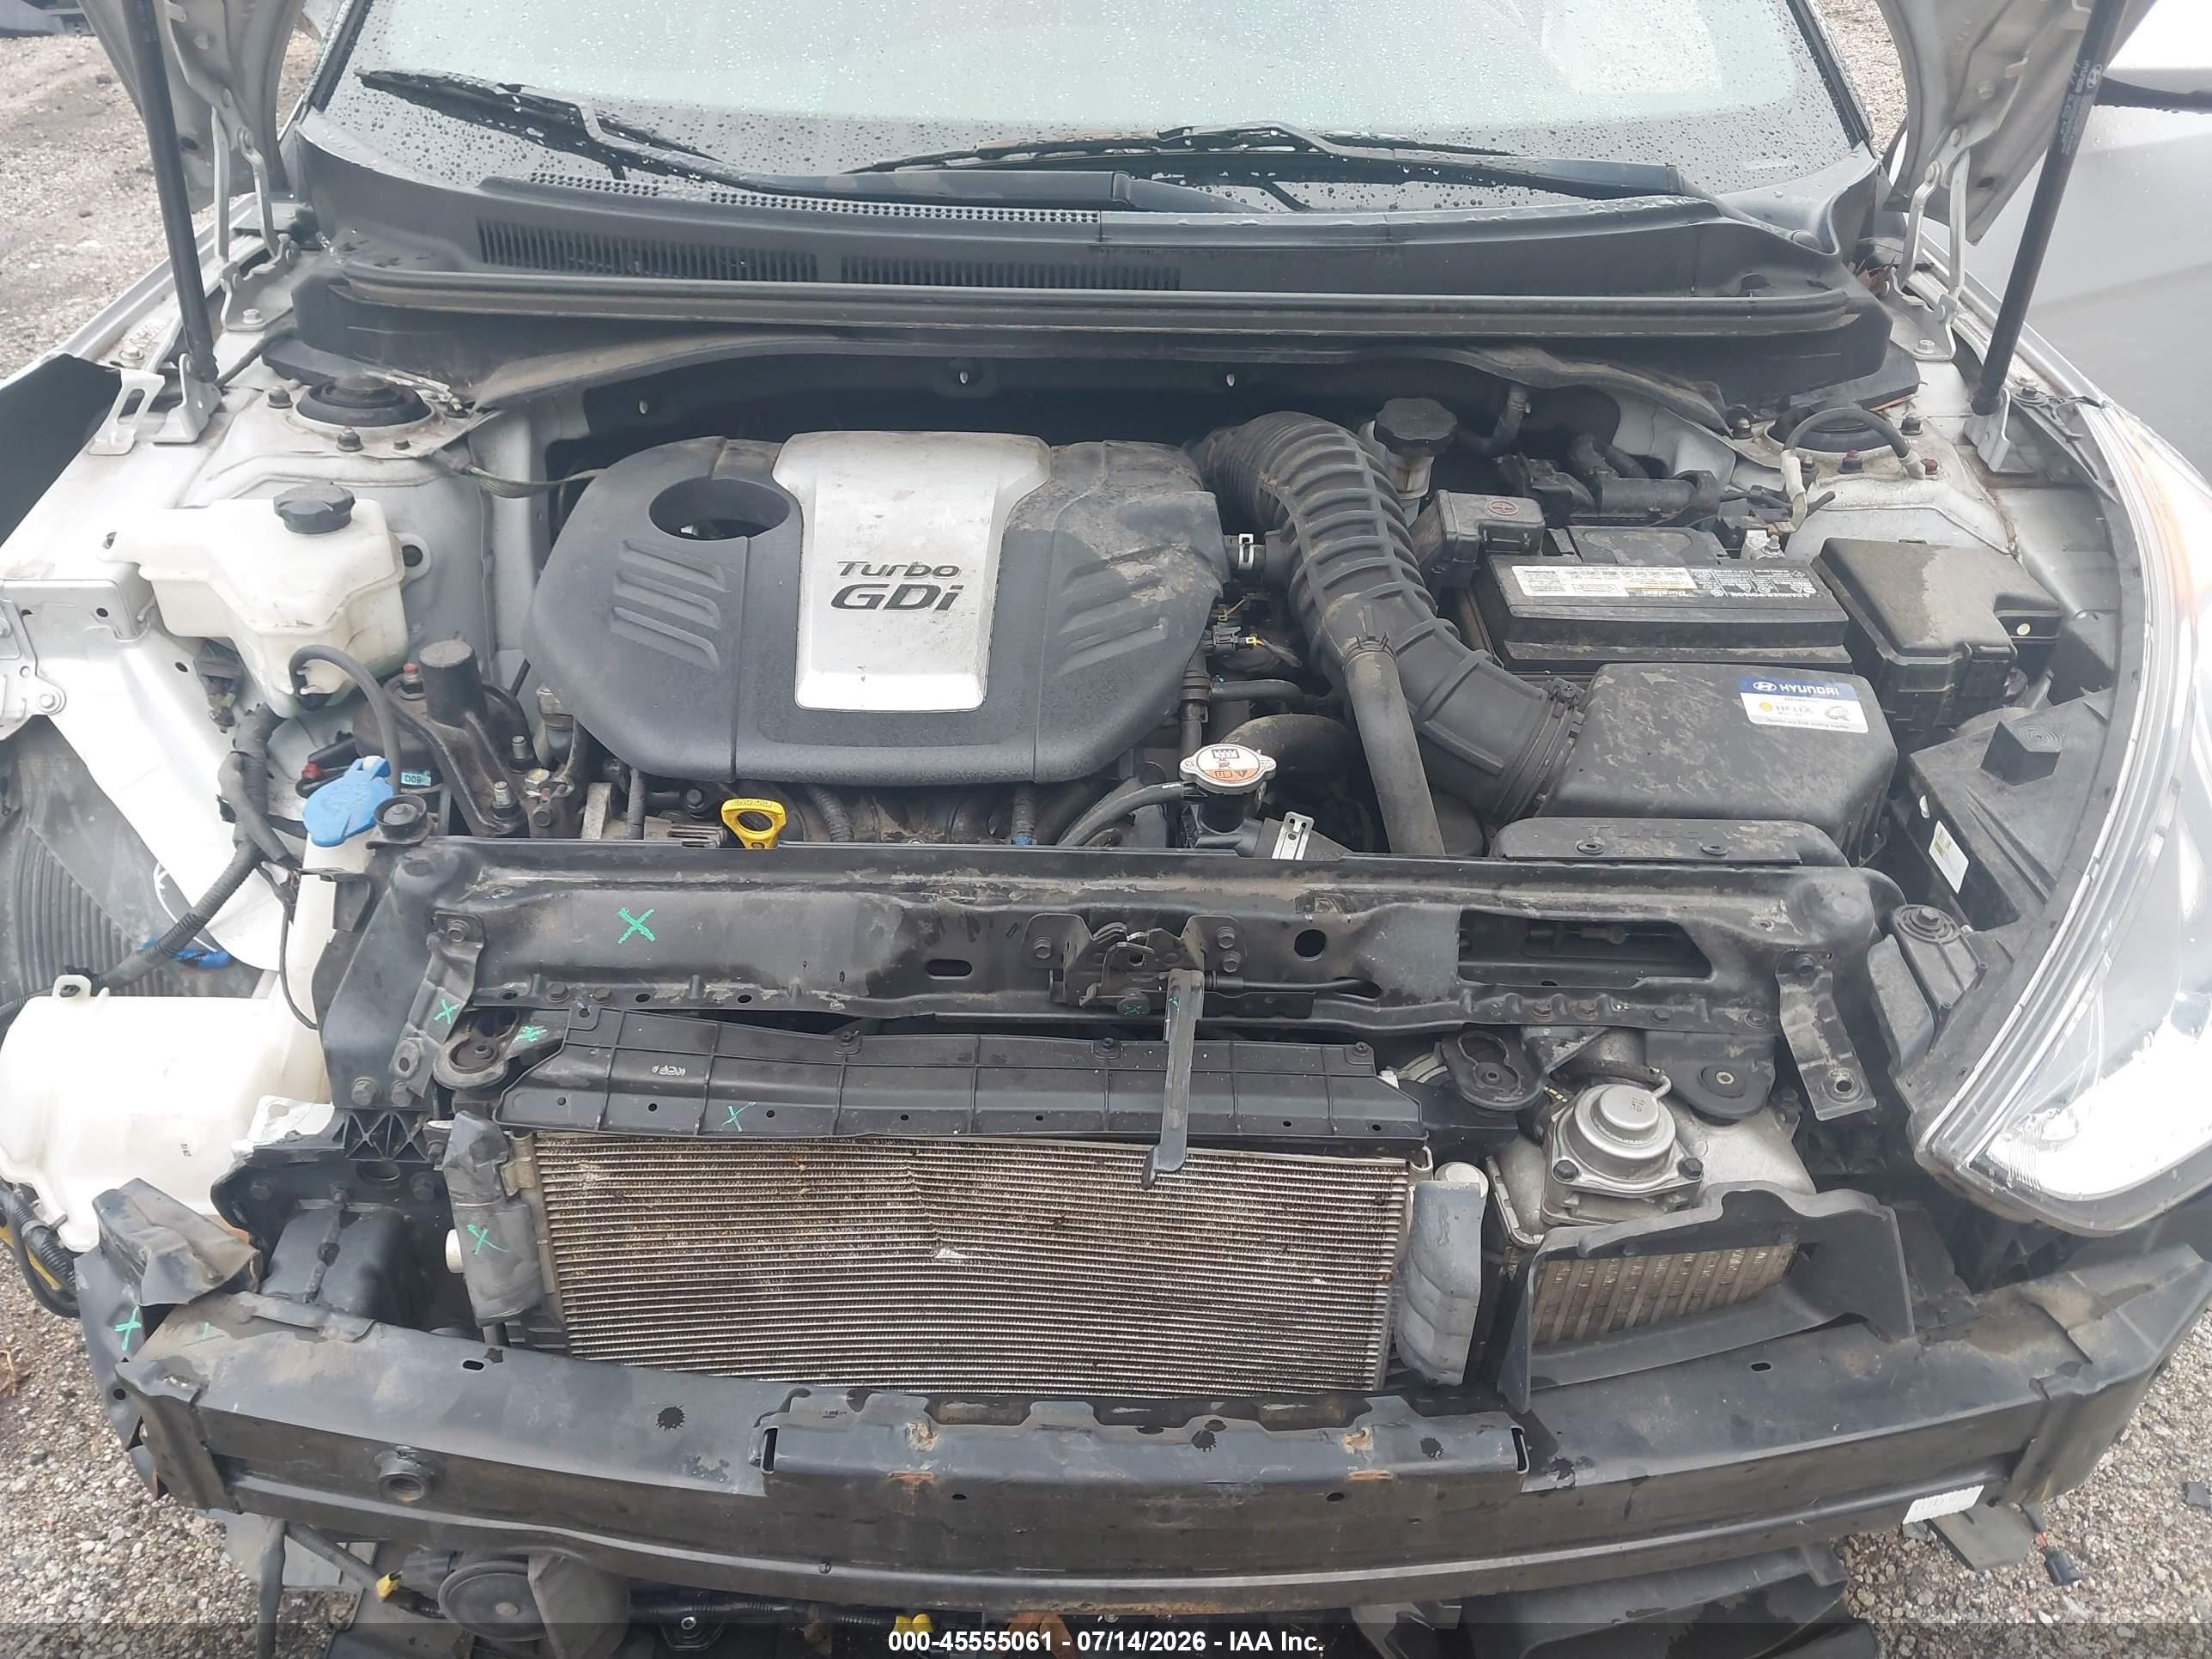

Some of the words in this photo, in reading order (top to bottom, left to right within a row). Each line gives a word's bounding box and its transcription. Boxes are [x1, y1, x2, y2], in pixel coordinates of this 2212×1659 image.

[837, 561, 960, 577] Turbo
[830, 584, 964, 611] GDi
[1778, 684, 1839, 696] HYUNDAI
